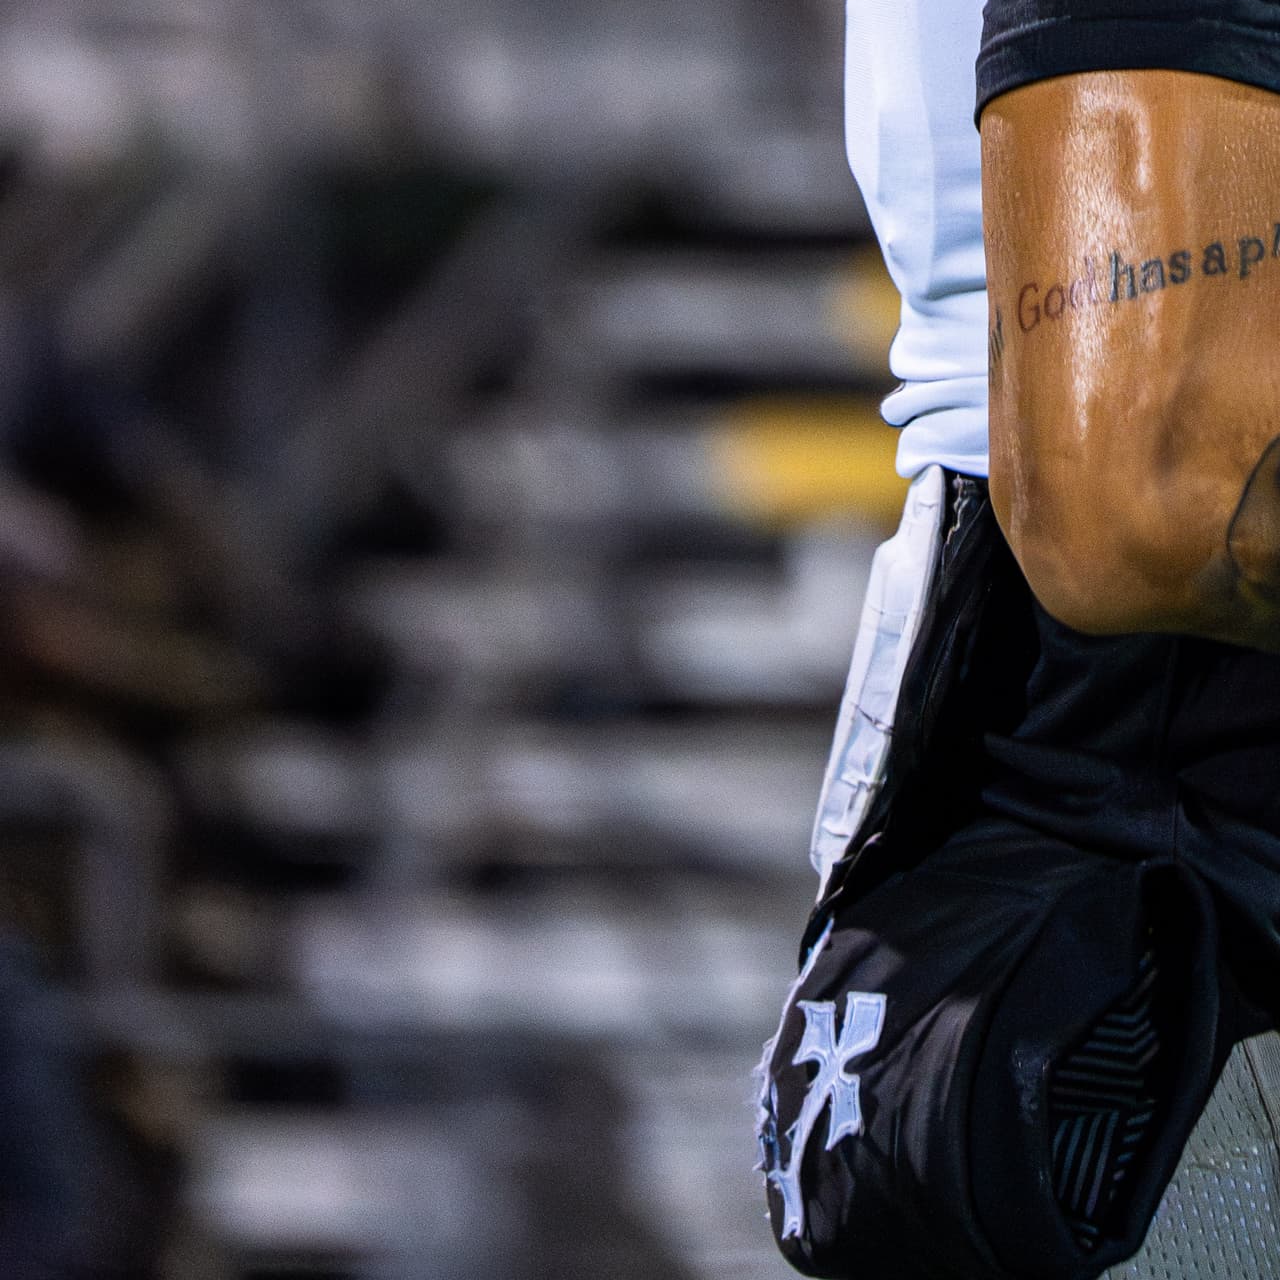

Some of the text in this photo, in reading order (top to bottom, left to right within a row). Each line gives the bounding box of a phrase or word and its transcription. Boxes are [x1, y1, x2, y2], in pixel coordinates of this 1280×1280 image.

[1018, 253, 1098, 334] God
[1107, 248, 1192, 303] has
[1202, 240, 1229, 277] a
